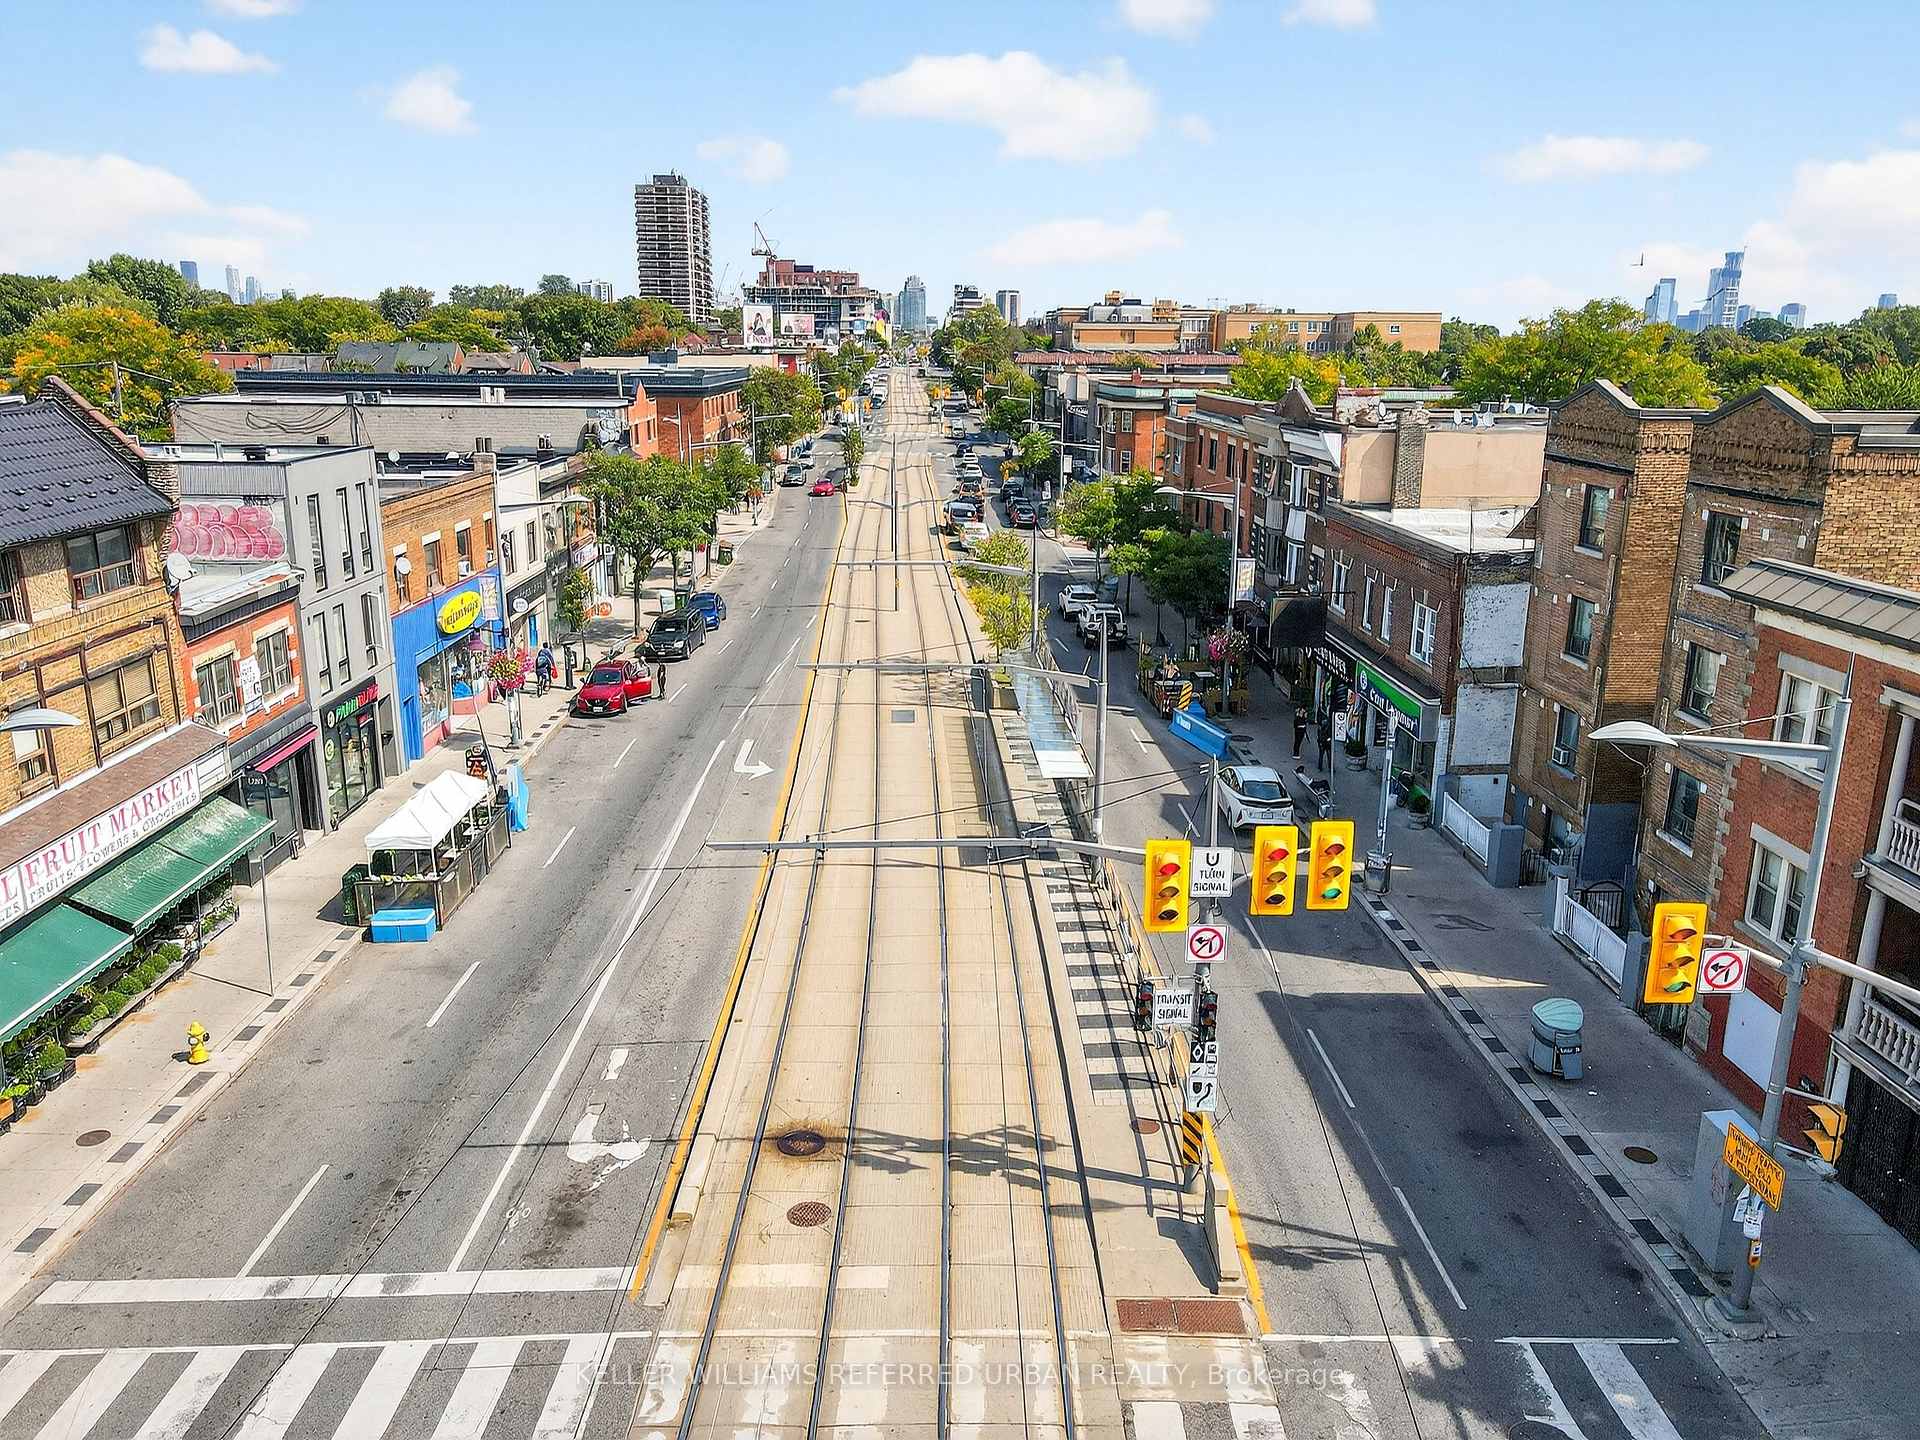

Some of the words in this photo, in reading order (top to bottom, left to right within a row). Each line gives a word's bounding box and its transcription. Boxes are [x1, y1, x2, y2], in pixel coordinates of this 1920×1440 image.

[25, 823, 101, 889] FRUIT
[109, 768, 194, 838] MARKET
[1200, 870, 1225, 879] TURN
[1193, 882, 1228, 892] SIGNAL
[1157, 993, 1192, 1005] TRANSIT
[1158, 1008, 1189, 1019] SIGNAL
